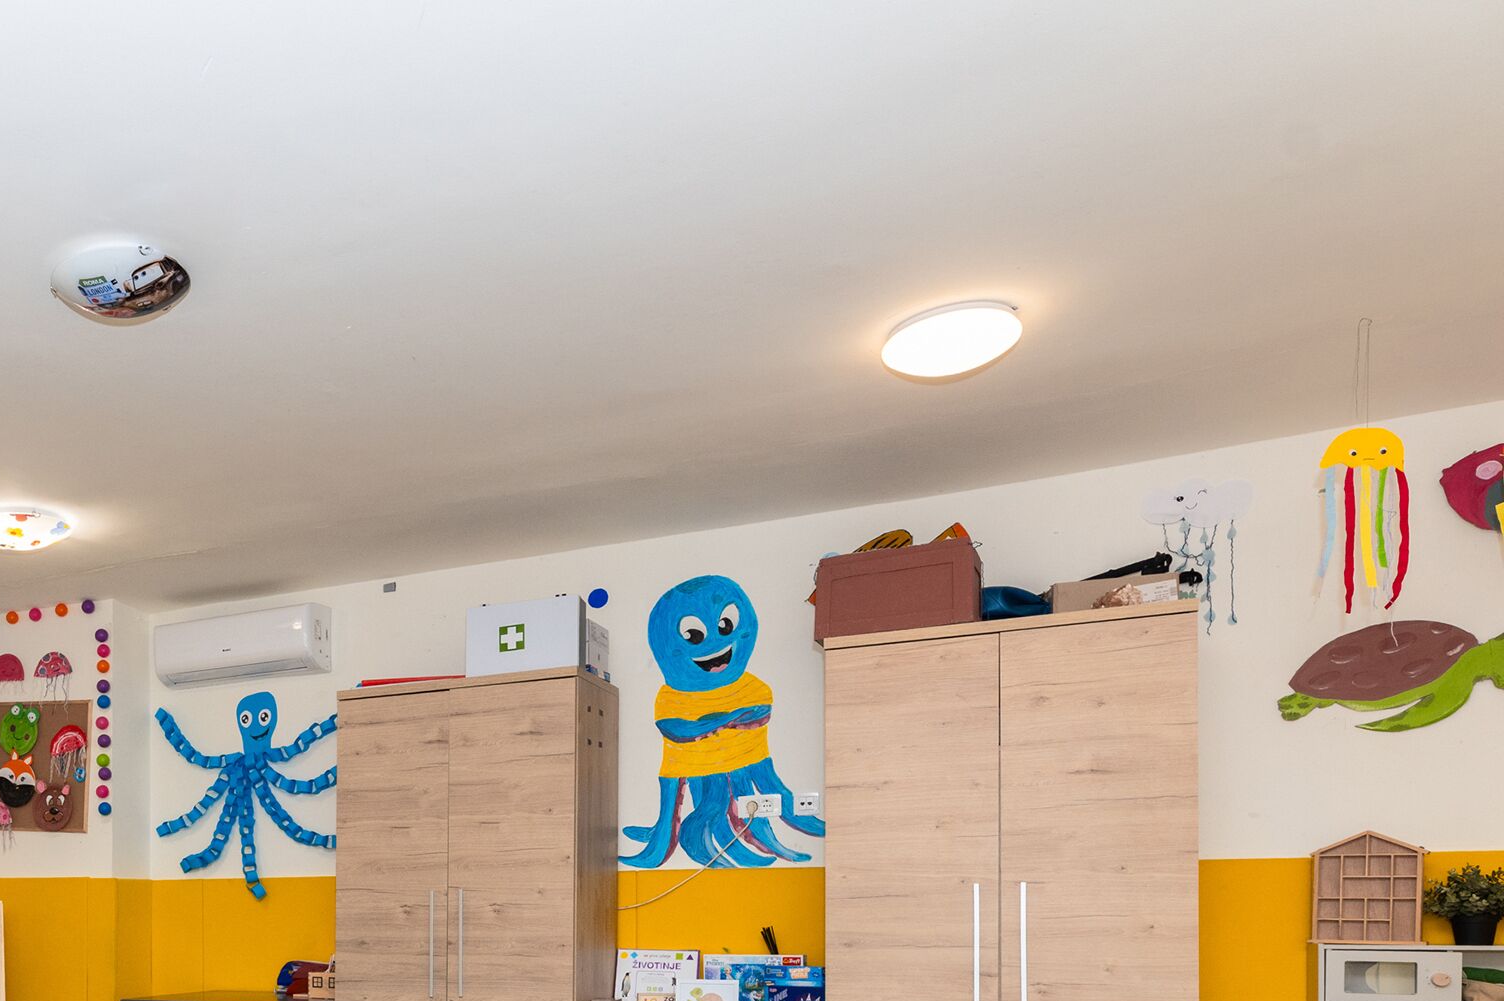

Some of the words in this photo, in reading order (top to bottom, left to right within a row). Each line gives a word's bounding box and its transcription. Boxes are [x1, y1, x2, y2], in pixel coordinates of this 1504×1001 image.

[83, 278, 104, 286] ROMA
[87, 284, 114, 296] LONDON
[632, 960, 682, 970] ŽIVOTINJE
